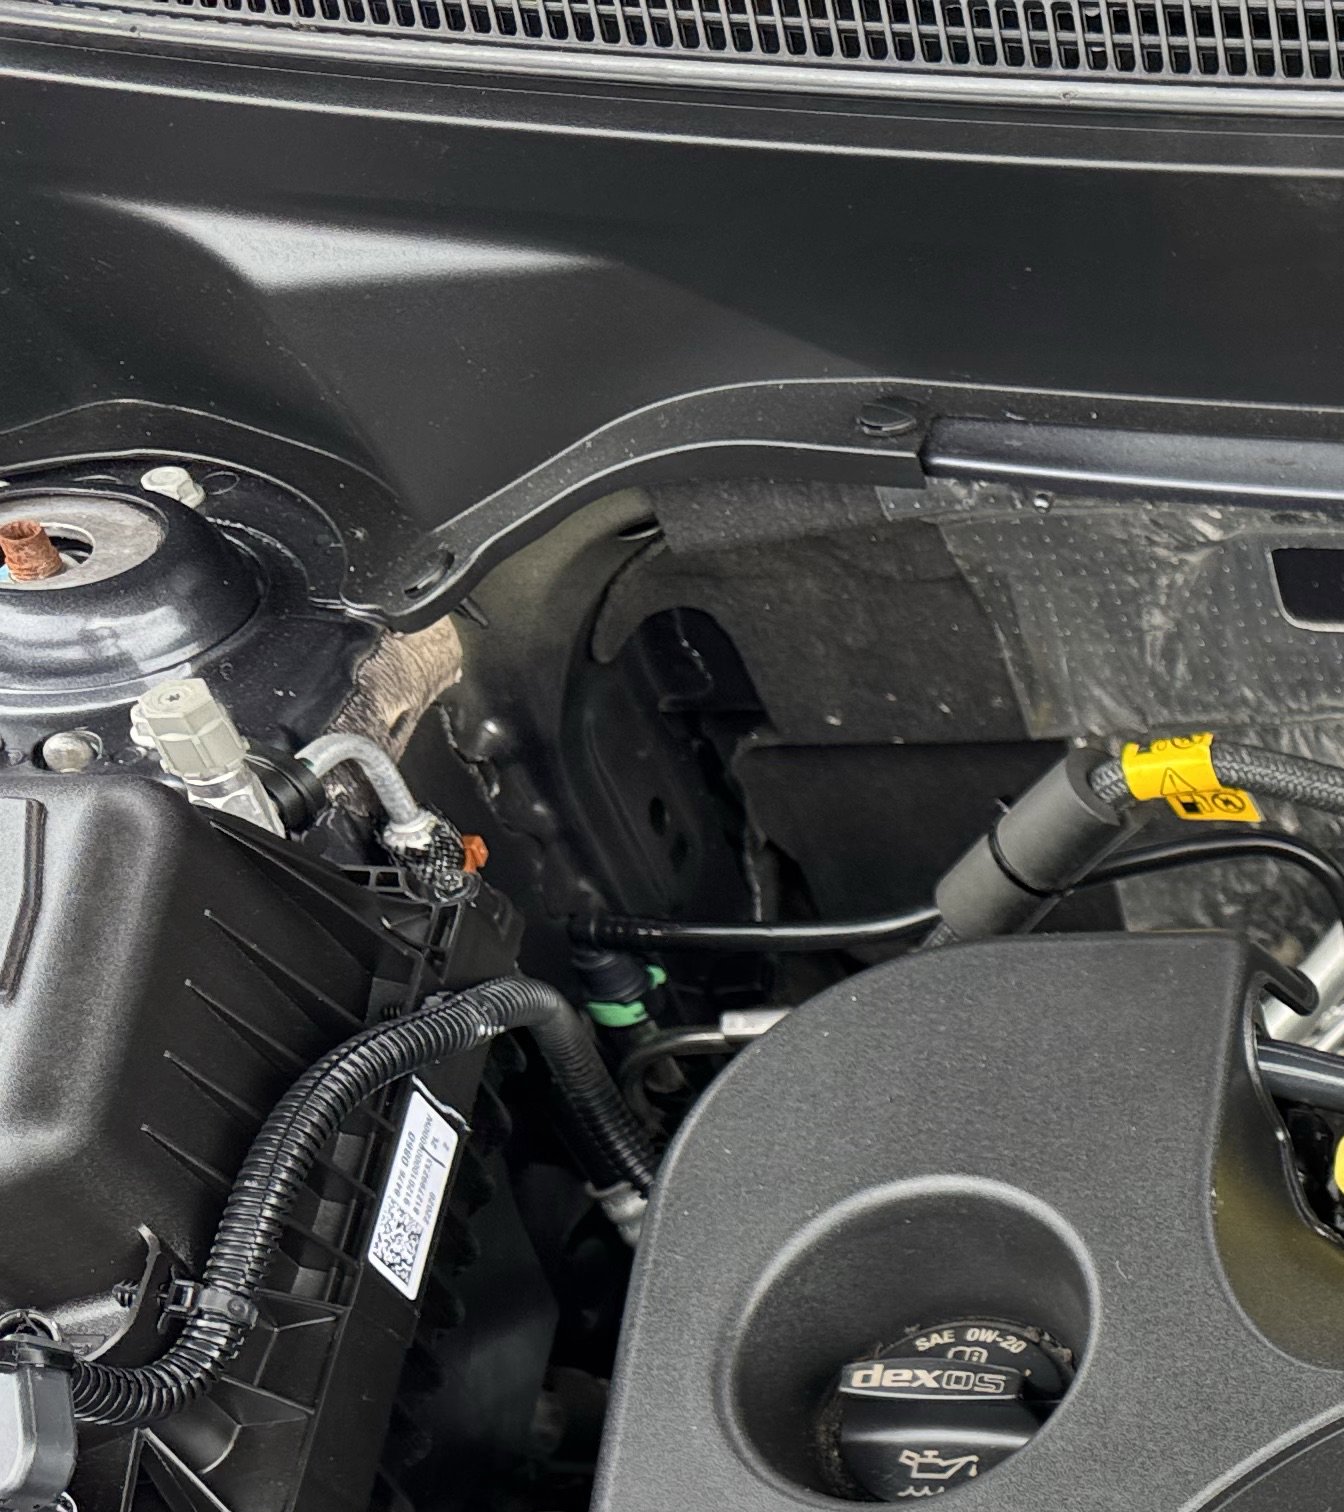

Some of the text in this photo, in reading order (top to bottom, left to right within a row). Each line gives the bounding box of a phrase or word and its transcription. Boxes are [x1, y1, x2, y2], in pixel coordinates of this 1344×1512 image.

[915, 1327, 1027, 1354] SAE 0W-20
[851, 1363, 1006, 1394] dexos
